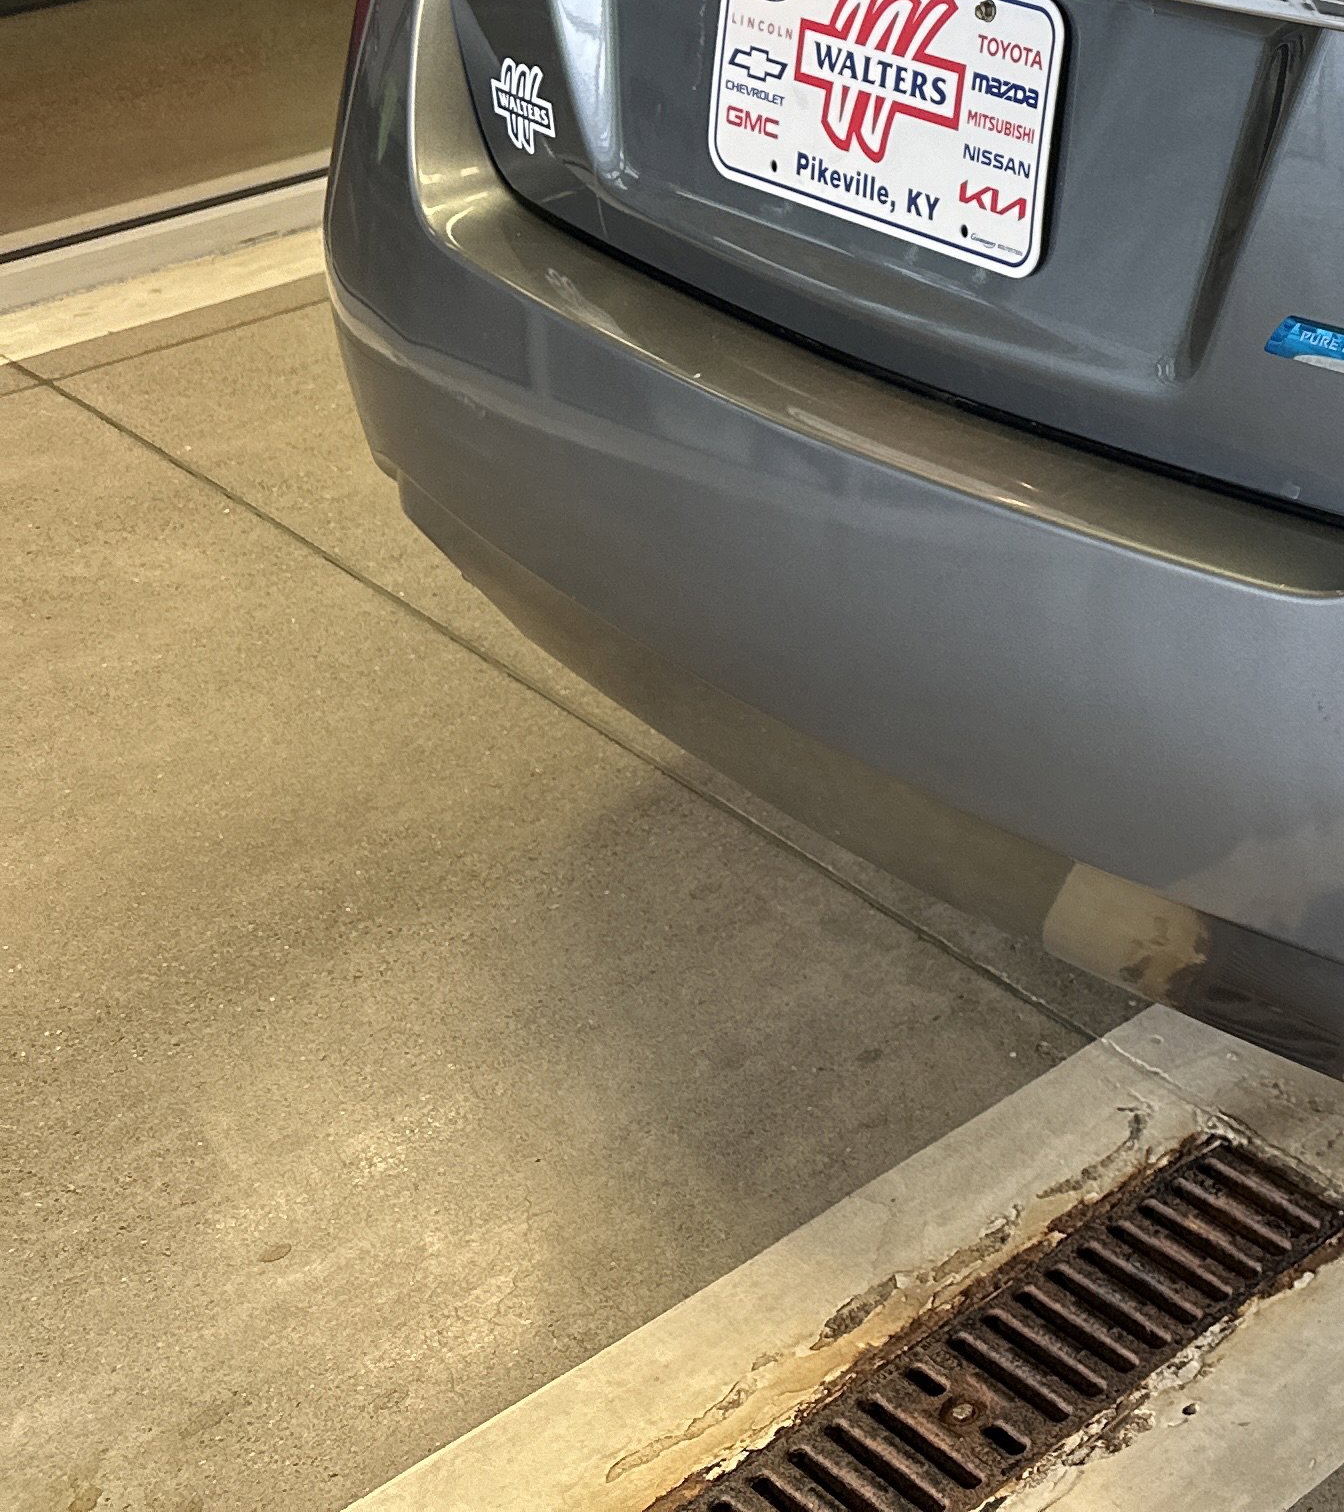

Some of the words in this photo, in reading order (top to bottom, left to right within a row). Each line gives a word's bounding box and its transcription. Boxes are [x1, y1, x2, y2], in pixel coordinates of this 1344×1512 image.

[732, 12, 793, 40] LINCOLN
[978, 34, 1043, 71] TOYOTA
[814, 40, 948, 106] WALTERS
[498, 92, 549, 126] WALTERS
[725, 79, 785, 107] CHEVROLET
[726, 105, 780, 139] GMC
[967, 109, 1035, 144] MITSUBISHI
[963, 144, 1031, 179] NISSAN
[796, 151, 896, 213] Pikeville,
[906, 188, 941, 221] KY
[1300, 330, 1338, 351] PURE
